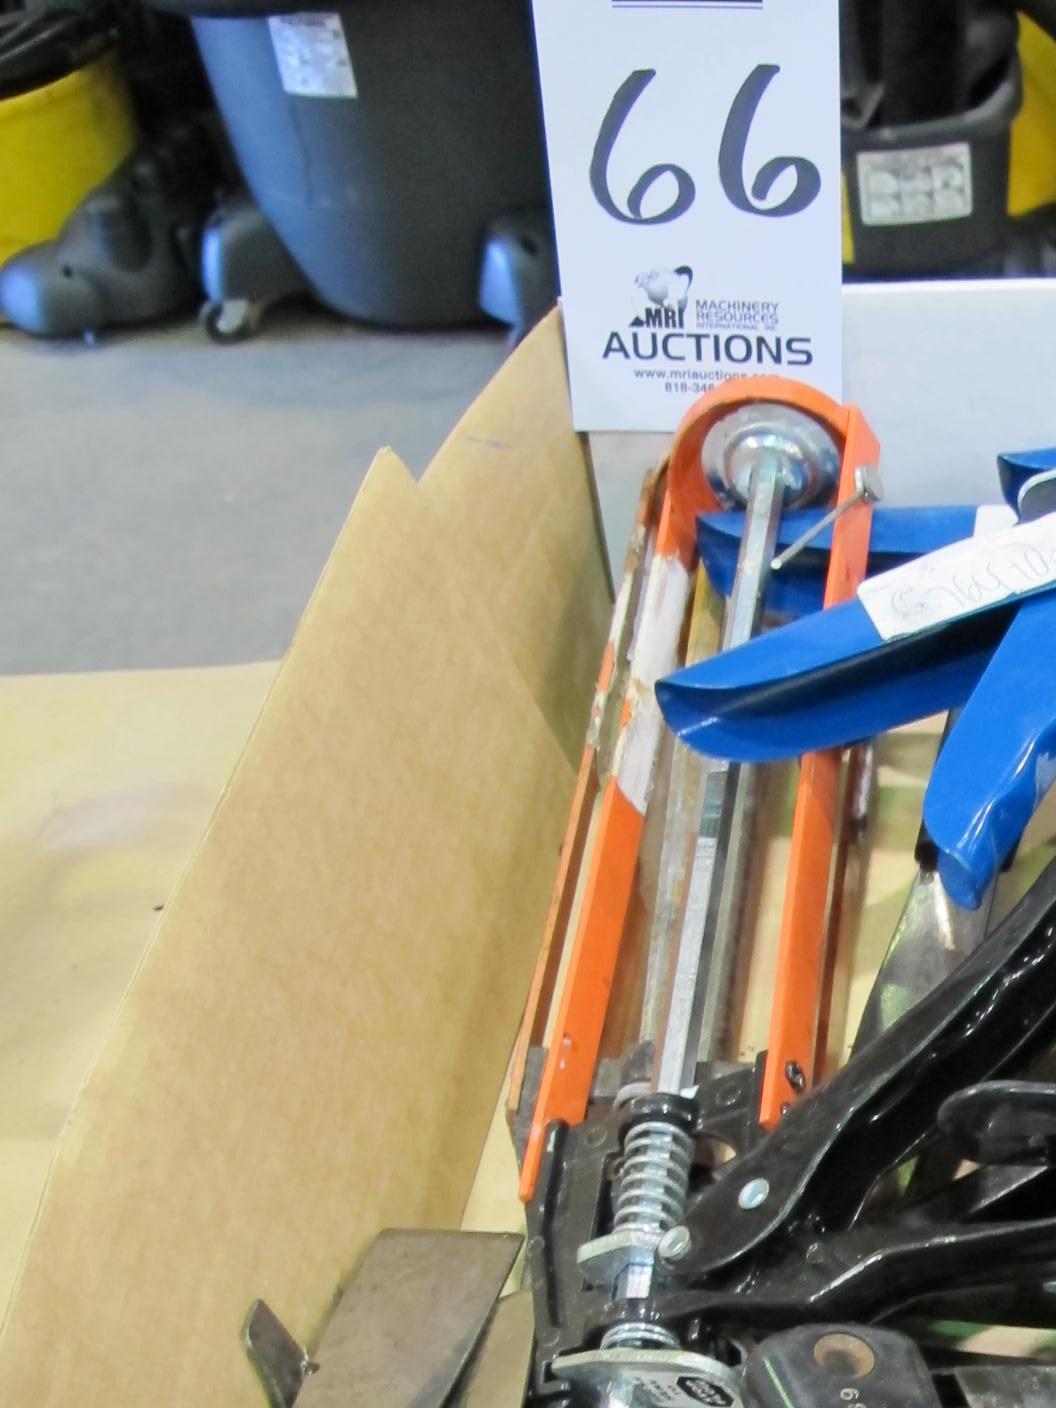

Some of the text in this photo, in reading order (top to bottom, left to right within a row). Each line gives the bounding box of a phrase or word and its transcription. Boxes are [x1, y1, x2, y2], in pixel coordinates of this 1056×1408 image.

[589, 64, 821, 225] 66
[644, 305, 685, 330] MRI
[696, 300, 780, 313] MACHINERY
[696, 312, 780, 325] RESOURCES
[602, 331, 813, 366] AUCTIONS
